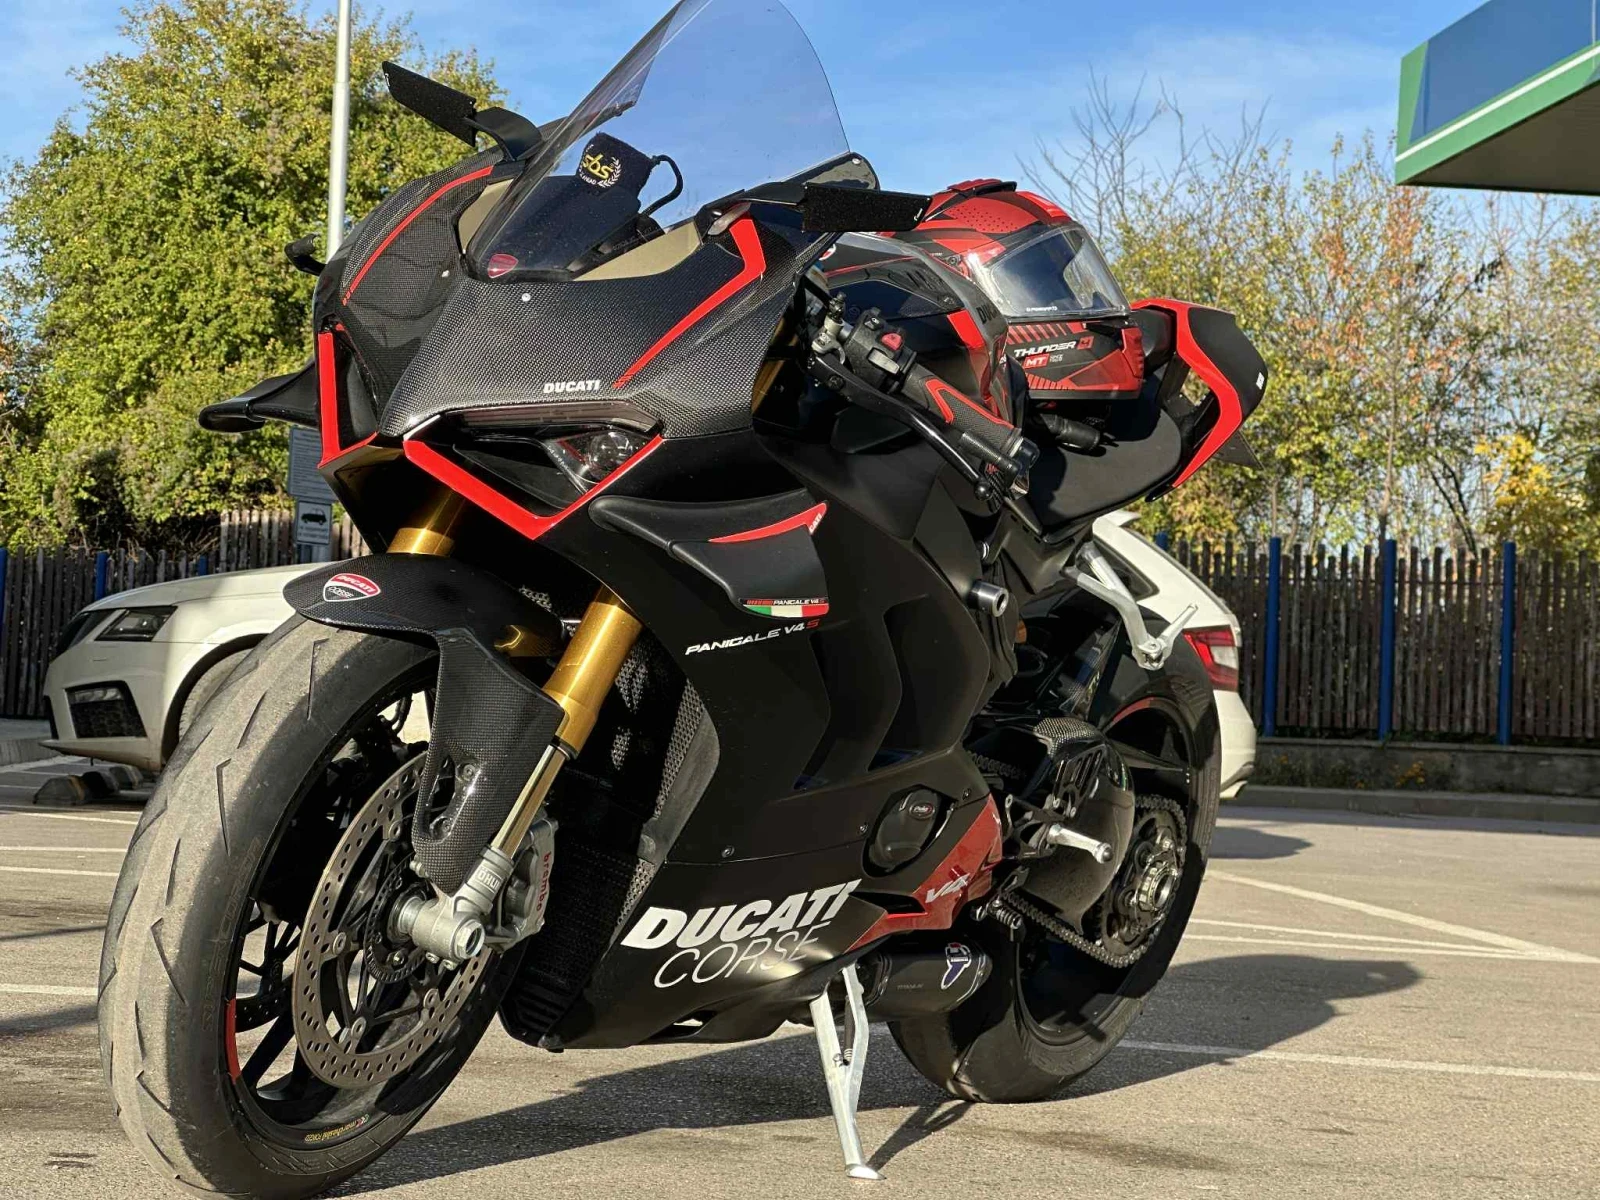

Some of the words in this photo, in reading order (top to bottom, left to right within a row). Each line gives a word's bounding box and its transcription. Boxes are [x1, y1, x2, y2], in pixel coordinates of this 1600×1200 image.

[582, 153, 614, 180] sbs
[1014, 340, 1077, 358] THUNDER
[1025, 356, 1047, 367] MT
[543, 380, 601, 393] DUCATI
[807, 513, 823, 534] CATI
[336, 575, 376, 593] DUCATI
[685, 628, 781, 656] PANIGALE
[536, 850, 552, 912] brembo
[620, 878, 862, 950] DUCATI
[654, 920, 831, 988] CORSE
